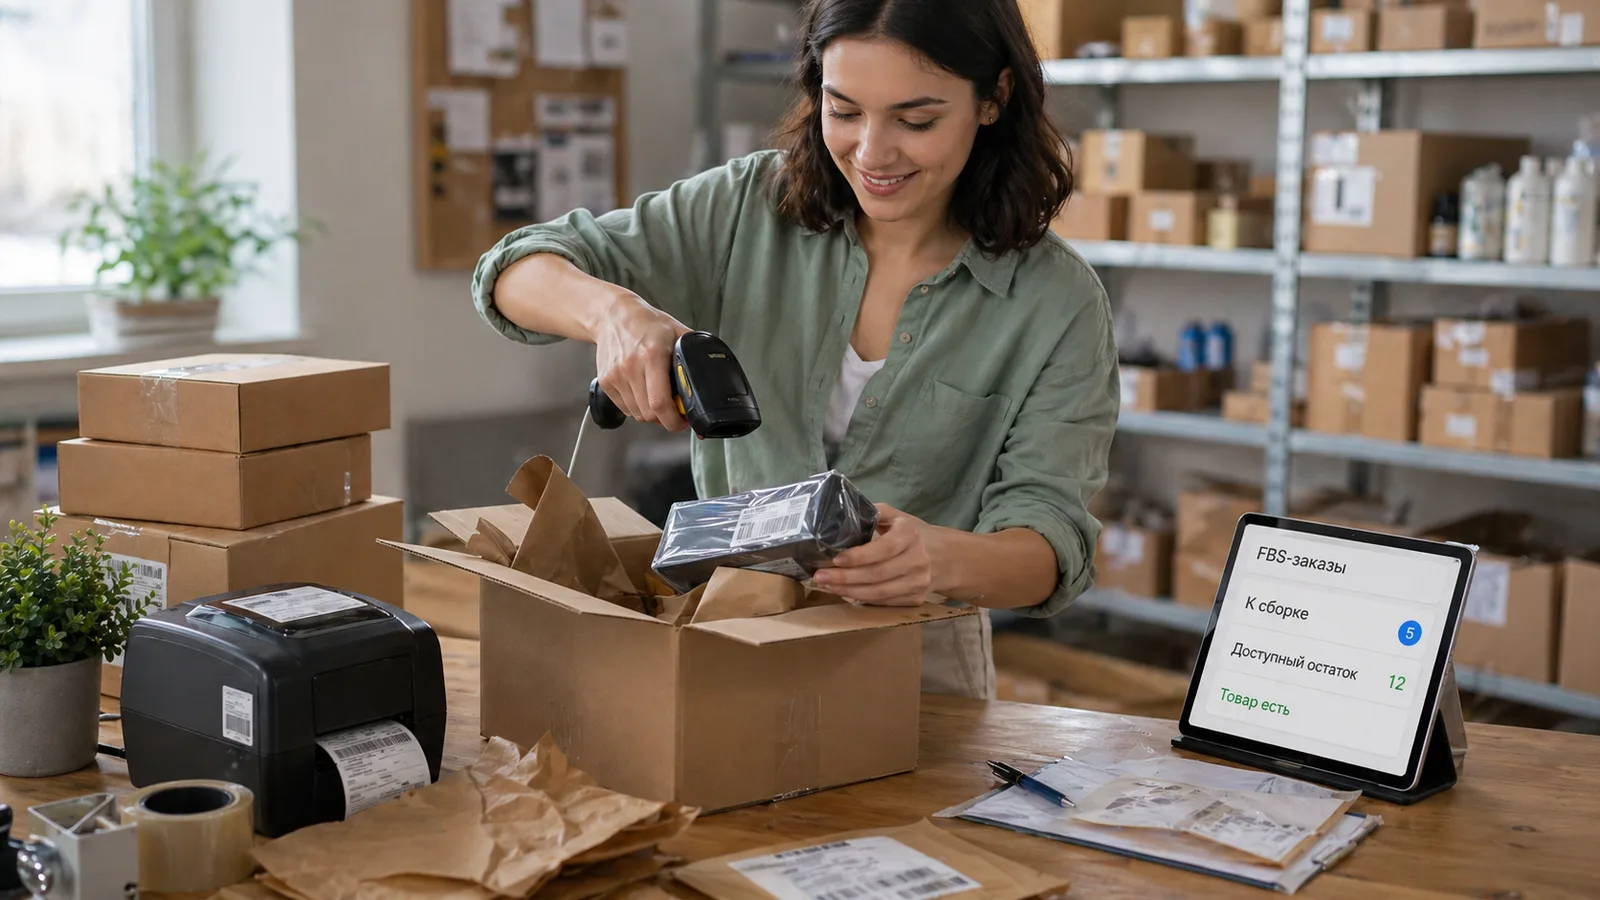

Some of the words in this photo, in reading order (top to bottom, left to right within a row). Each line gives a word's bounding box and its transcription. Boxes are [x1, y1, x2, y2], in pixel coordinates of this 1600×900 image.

[1257, 546, 1346, 574] FBS-заказы
[1245, 596, 1256, 610] К
[1258, 600, 1309, 621] сборке
[1405, 626, 1415, 640] 5
[1230, 642, 1305, 669] Доступный
[1307, 661, 1359, 681] остаток
[1389, 674, 1406, 692] 12
[1220, 687, 1259, 711] Товар
[1260, 700, 1290, 716] есть
